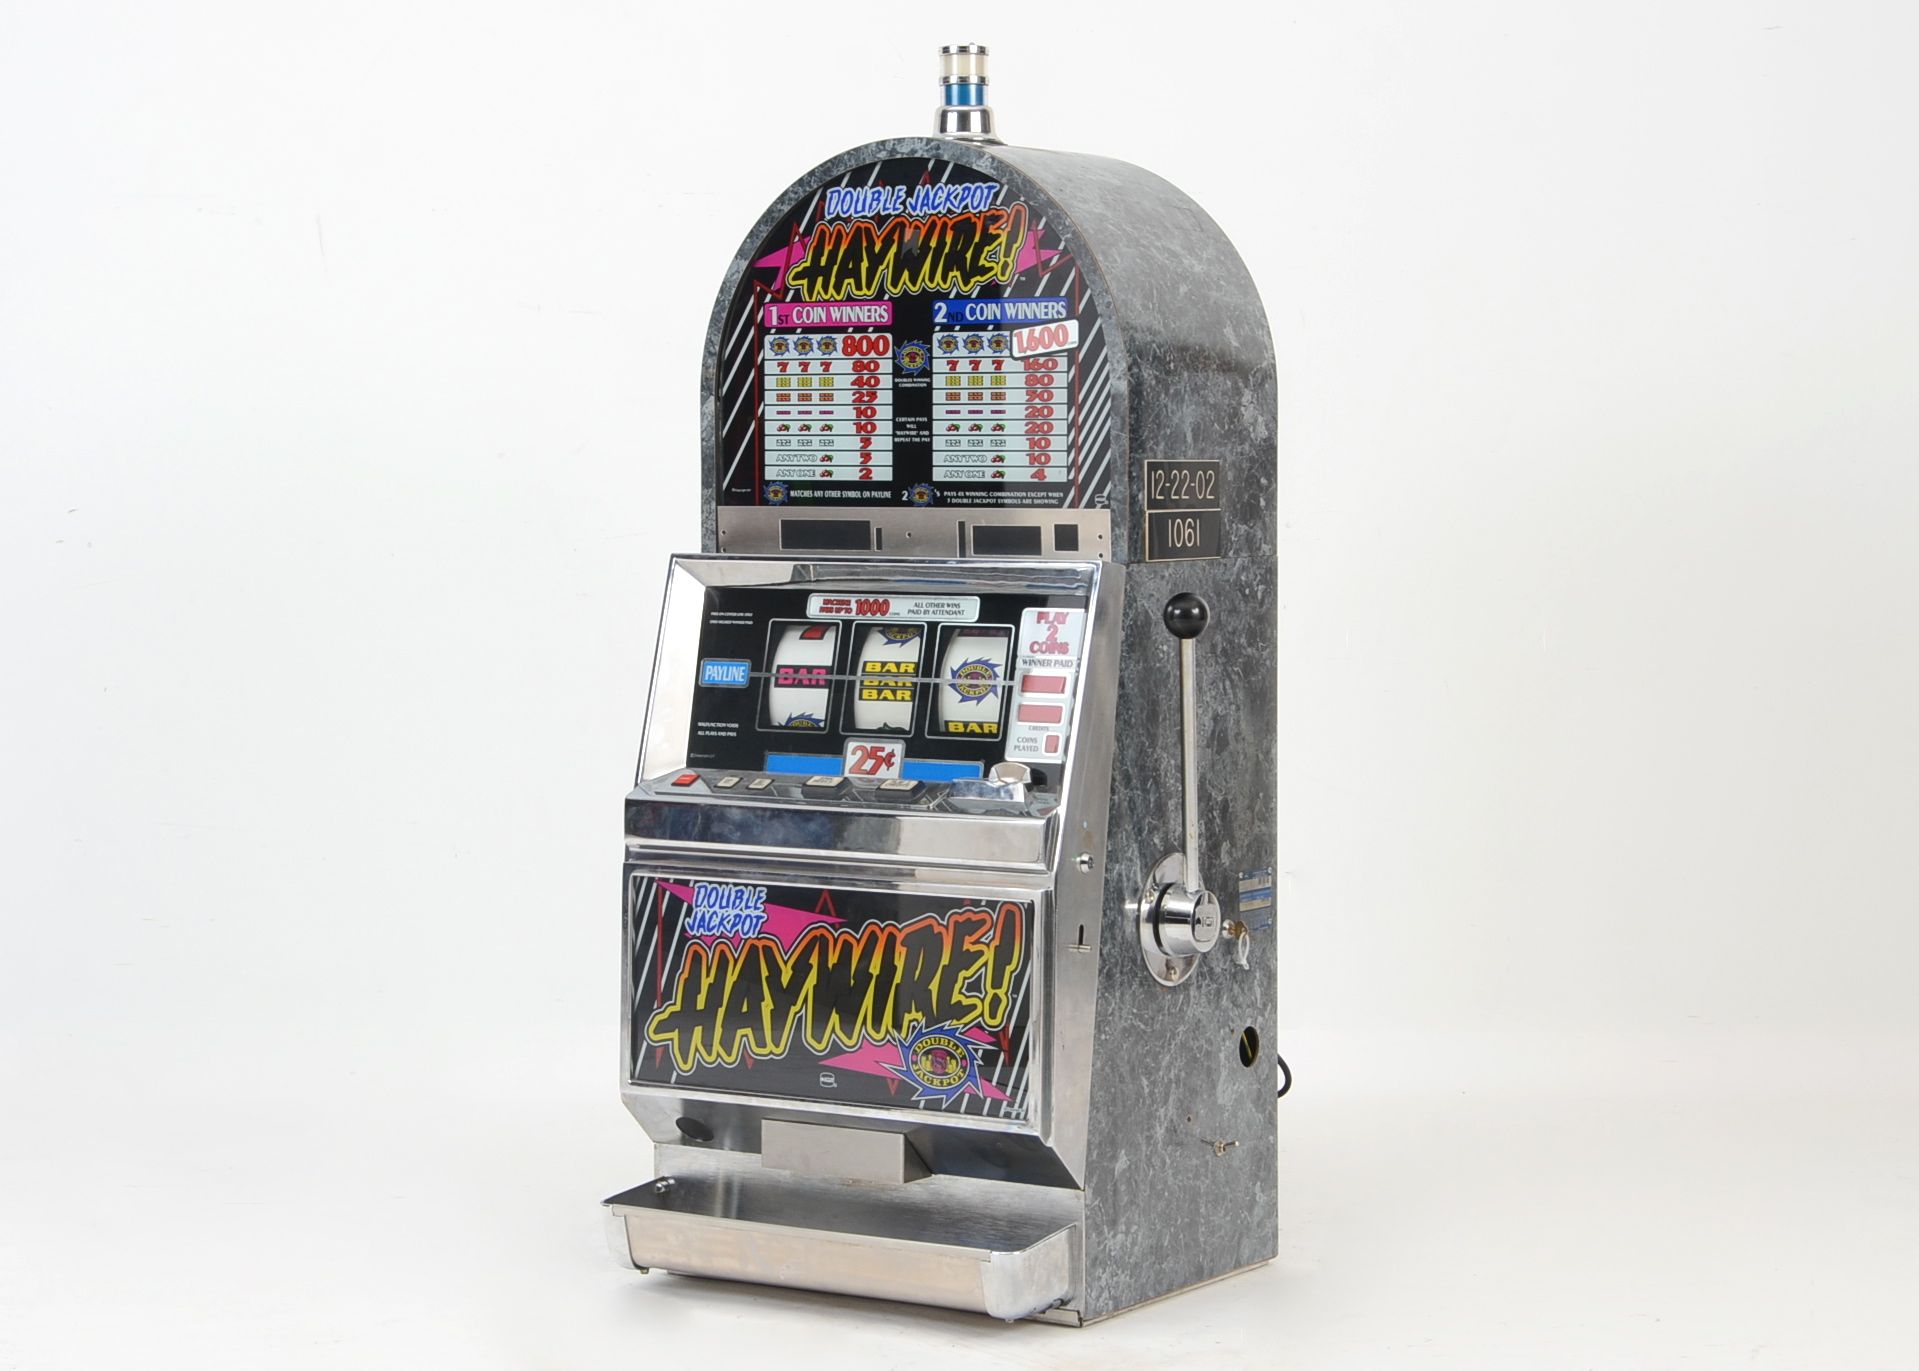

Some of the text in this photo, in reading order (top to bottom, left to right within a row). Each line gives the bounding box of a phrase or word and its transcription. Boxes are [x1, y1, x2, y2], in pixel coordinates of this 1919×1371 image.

[824, 182, 999, 219] DOUBLE JACKPOT
[786, 201, 1029, 302] HAYWIRE!
[792, 306, 826, 324] COIN
[830, 304, 889, 323] WINNERS
[965, 303, 1000, 320] COIN
[1005, 301, 1066, 320] WINNERS
[842, 334, 890, 356] 800
[776, 360, 880, 372] 7 7 7 80
[946, 358, 1058, 372] 7 7 7 160
[850, 376, 880, 388] 40
[1024, 374, 1054, 386] 80
[852, 391, 878, 404] 25
[1025, 389, 1054, 402] 50
[852, 406, 877, 419] 10
[1024, 406, 1054, 418] 20
[852, 421, 877, 434] 10
[1024, 421, 1054, 434] 20
[859, 437, 872, 449] 5
[1026, 437, 1052, 450] 10
[776, 452, 872, 464] ANY TWO 5
[943, 452, 1052, 466] ANY TWO 10
[776, 468, 873, 480] ANY ONE 2
[943, 468, 1048, 480] ANY ONE 4
[1152, 470, 1215, 500] 12-22-02
[790, 490, 812, 498] MATCHES
[814, 490, 824, 498] ANY
[824, 490, 840, 498] OTHER
[842, 490, 861, 498] SYMBOL
[902, 491, 908, 500] 2
[1168, 518, 1200, 548] 1061
[855, 598, 890, 616] 1000
[931, 608, 965, 616] ATTENDANT
[1036, 612, 1070, 624] PLAY
[1046, 624, 1060, 642] 2
[1030, 641, 1070, 655] COINS
[865, 662, 916, 672] BAR
[1022, 659, 1074, 668] WINNER PAID
[705, 666, 746, 682] PAYLINE
[778, 668, 827, 685] BAR
[862, 689, 912, 700] BAR
[948, 722, 998, 734] BAR
[1016, 736, 1038, 744] COINS
[1014, 744, 1039, 752] PLAYED
[848, 745, 897, 776] 25¢
[694, 882, 767, 912] DOUBLE
[685, 911, 767, 938] JACKPOT
[645, 901, 1025, 1075] HAYWIRE!
[914, 1037, 964, 1058] DOUBLE
[912, 1064, 966, 1086] JACKPOT
